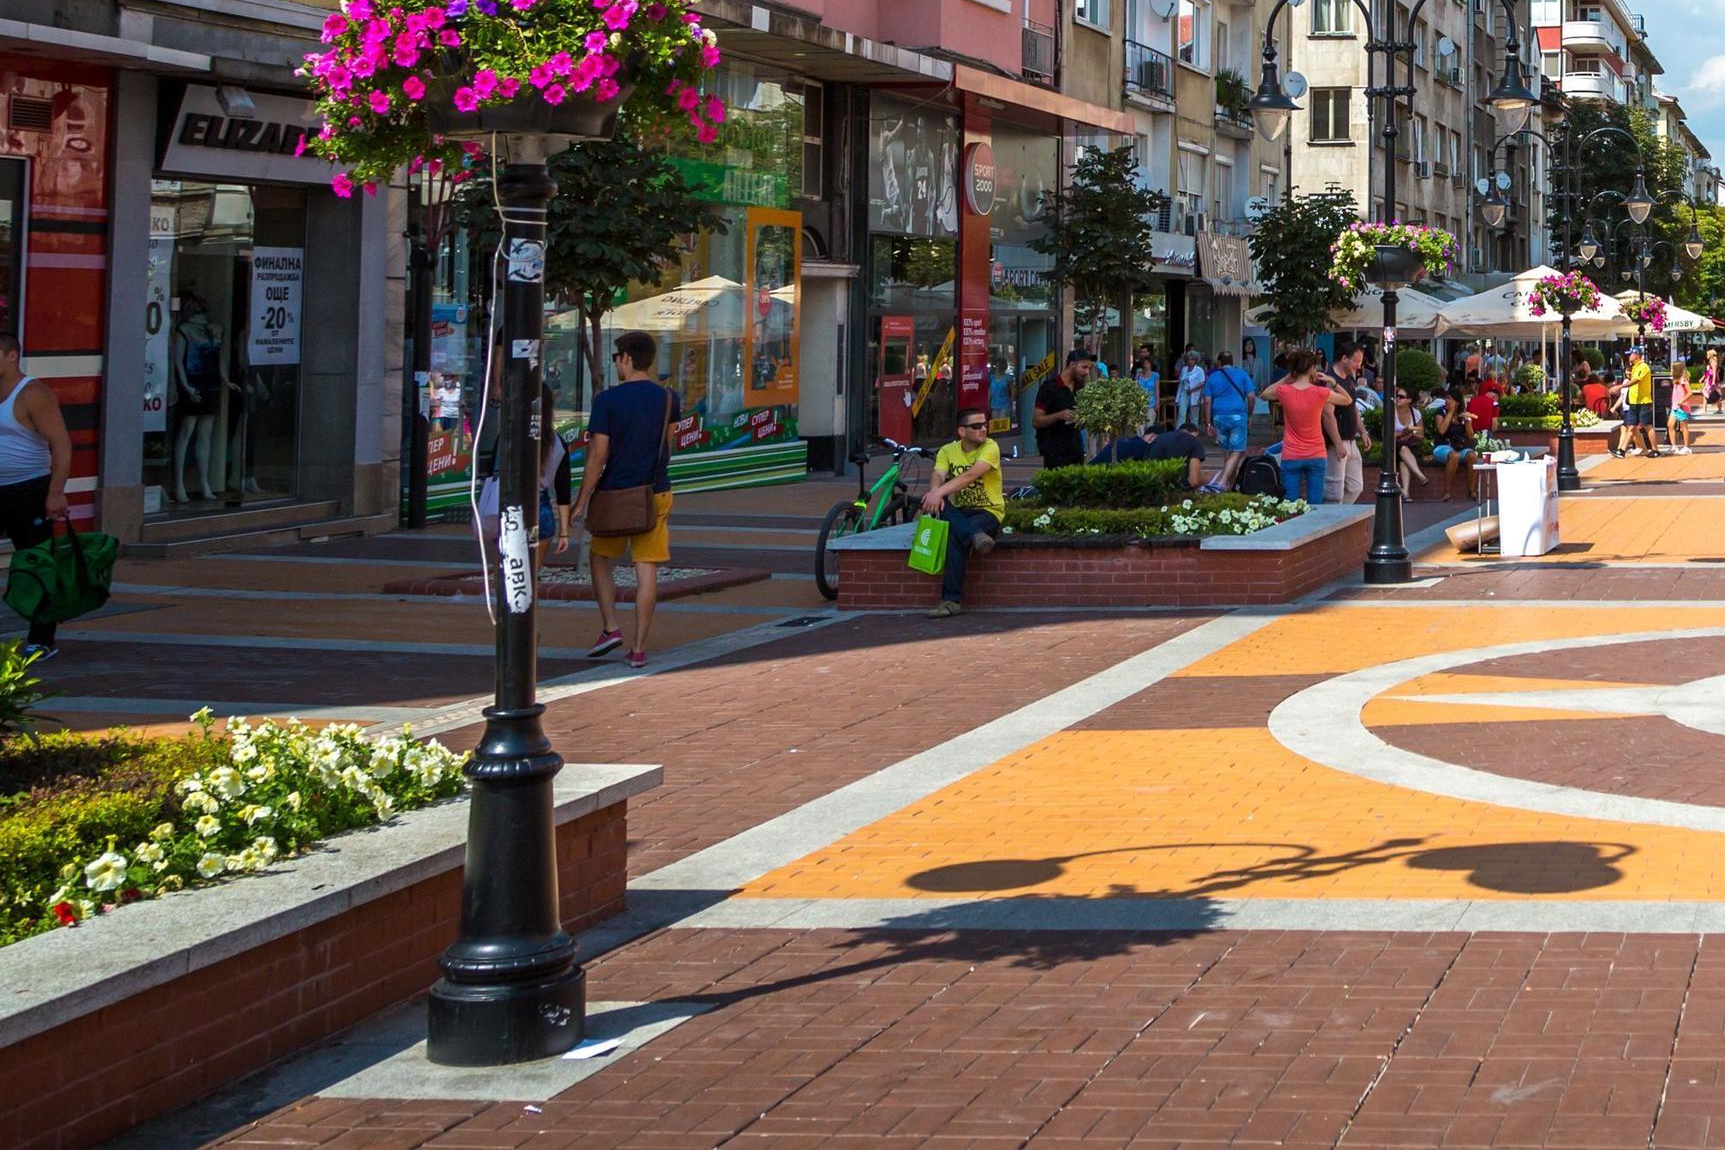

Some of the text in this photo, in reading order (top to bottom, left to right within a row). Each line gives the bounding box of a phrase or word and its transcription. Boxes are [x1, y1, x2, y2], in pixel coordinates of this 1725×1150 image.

[974, 163, 994, 179] SPORT
[975, 178, 993, 193] 2000
[254, 257, 301, 270] ФИНАЛНА
[266, 286, 289, 303] ОЩЕ
[751, 410, 770, 426] СУПЕР
